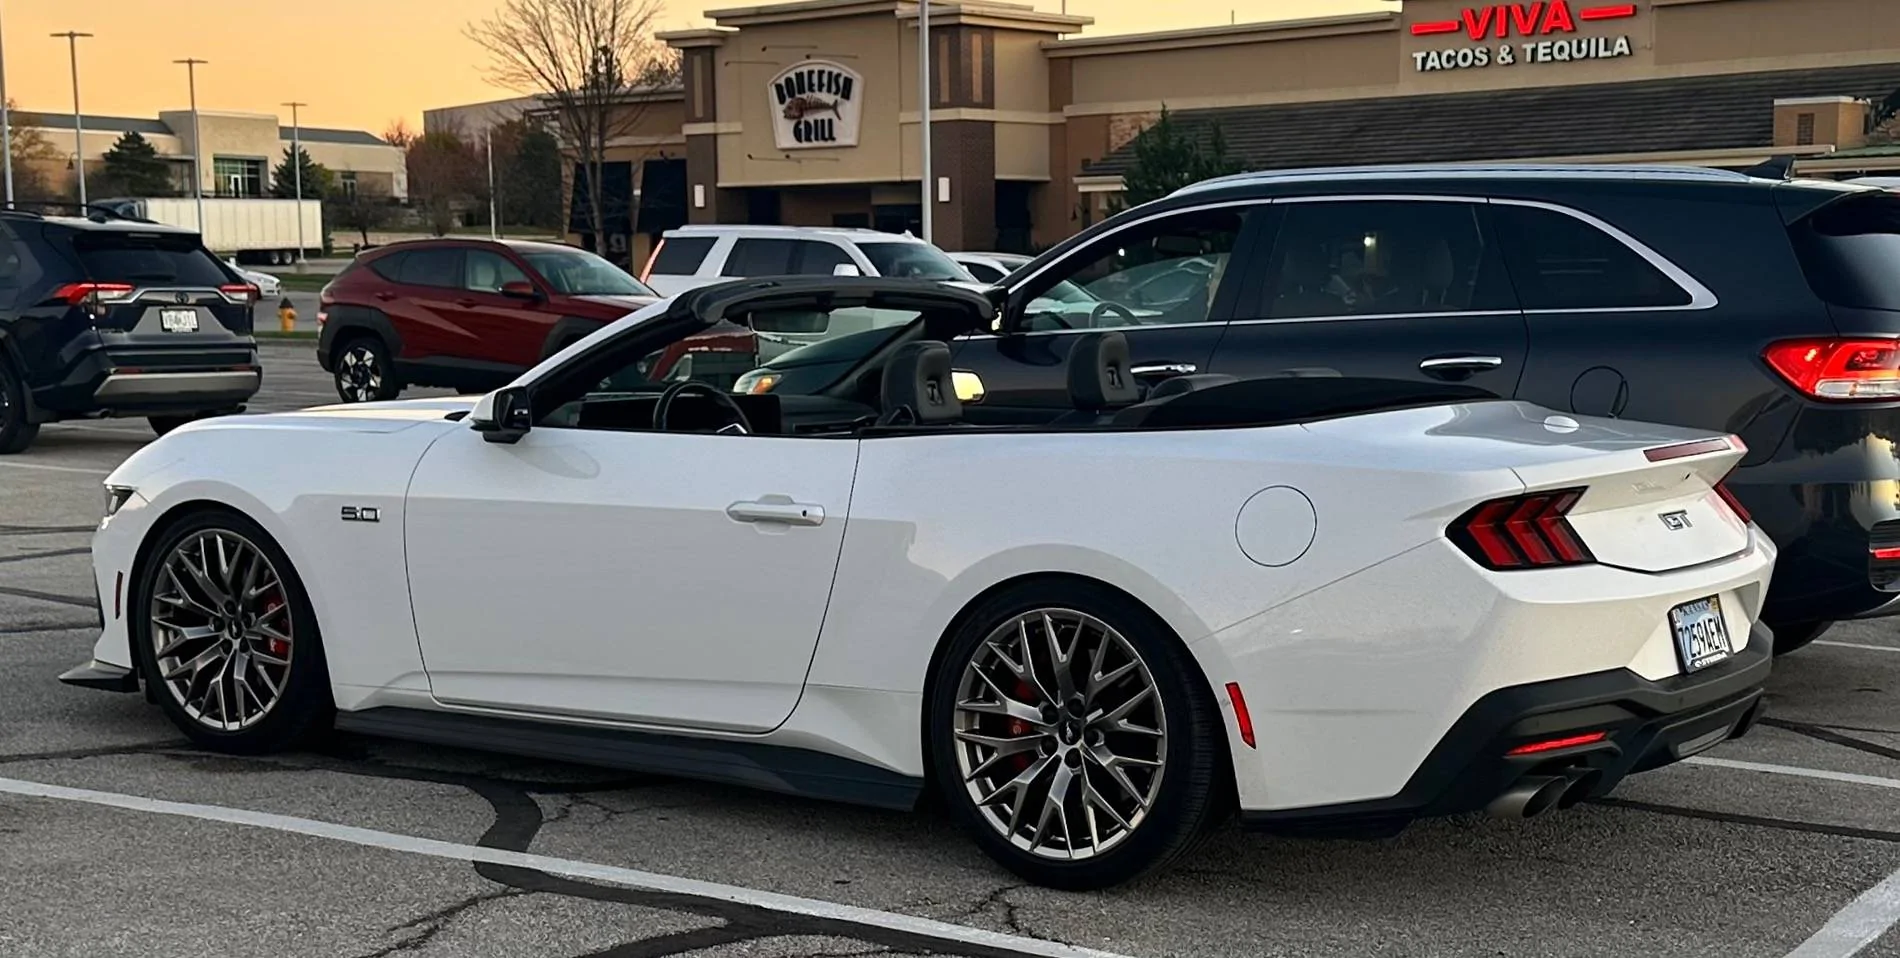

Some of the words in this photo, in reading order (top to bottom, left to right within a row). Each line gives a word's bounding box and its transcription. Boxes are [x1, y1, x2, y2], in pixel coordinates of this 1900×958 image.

[1461, 0, 1576, 40] VIVA
[1412, 46, 1489, 72] TACOS
[1496, 45, 1515, 66] &
[1521, 36, 1632, 64] TEQUILA
[774, 69, 854, 105] BONEFISH
[793, 118, 836, 143] GRILL
[1657, 509, 1693, 531] GT
[1677, 615, 1727, 663] 7259AEM
